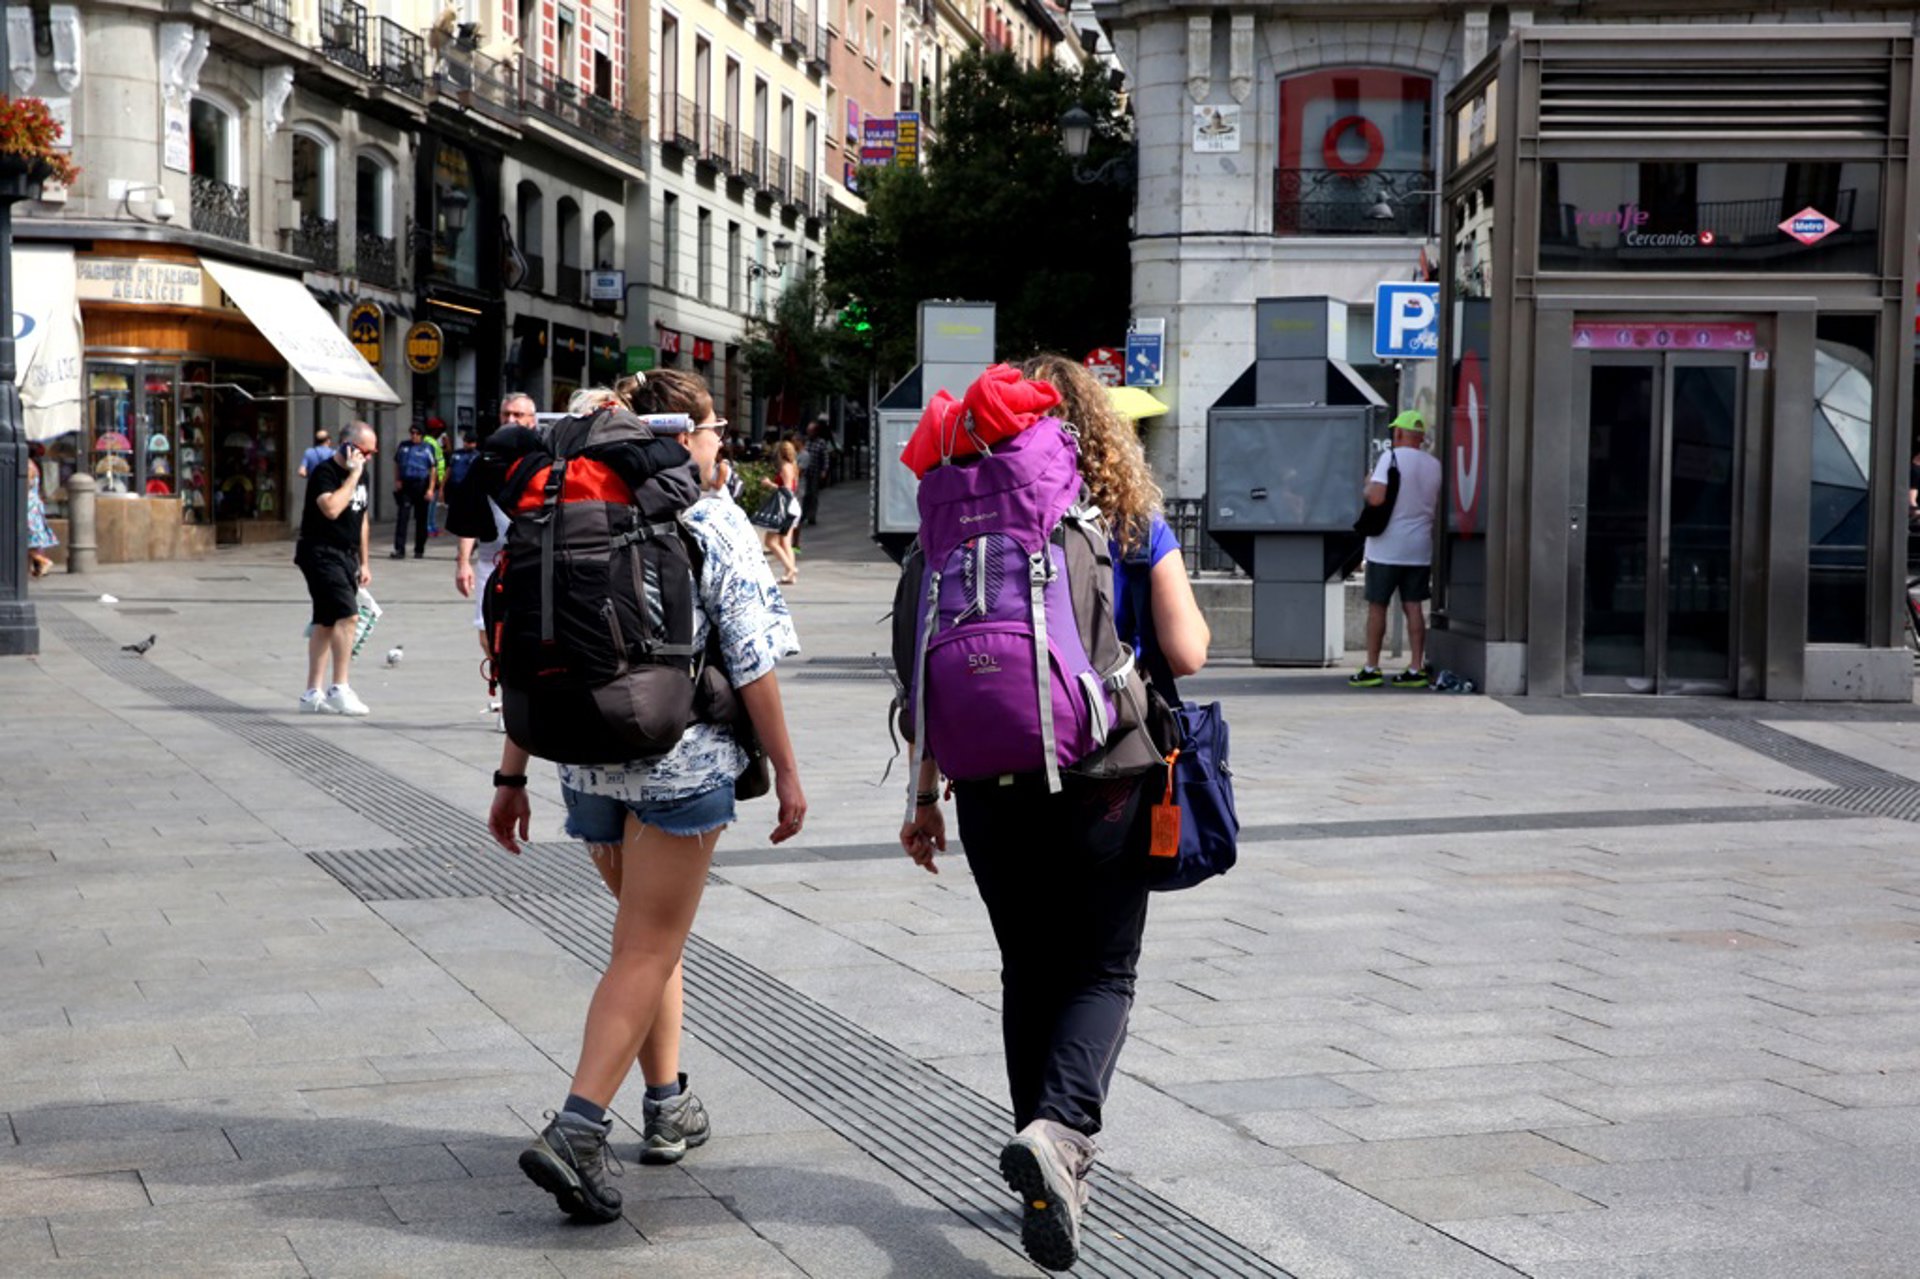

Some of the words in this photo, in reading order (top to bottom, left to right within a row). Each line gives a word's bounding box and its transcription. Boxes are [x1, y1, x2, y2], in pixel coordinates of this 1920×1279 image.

[865, 130, 896, 140] VIAJES
[1575, 202, 1649, 232] renfe
[1795, 221, 1823, 231] Metro
[1626, 230, 1696, 247] Cercanías
[1389, 292, 1434, 349] P
[409, 340, 438, 356] ORO
[661, 330, 679, 353] KFC
[968, 652, 989, 667] 50
